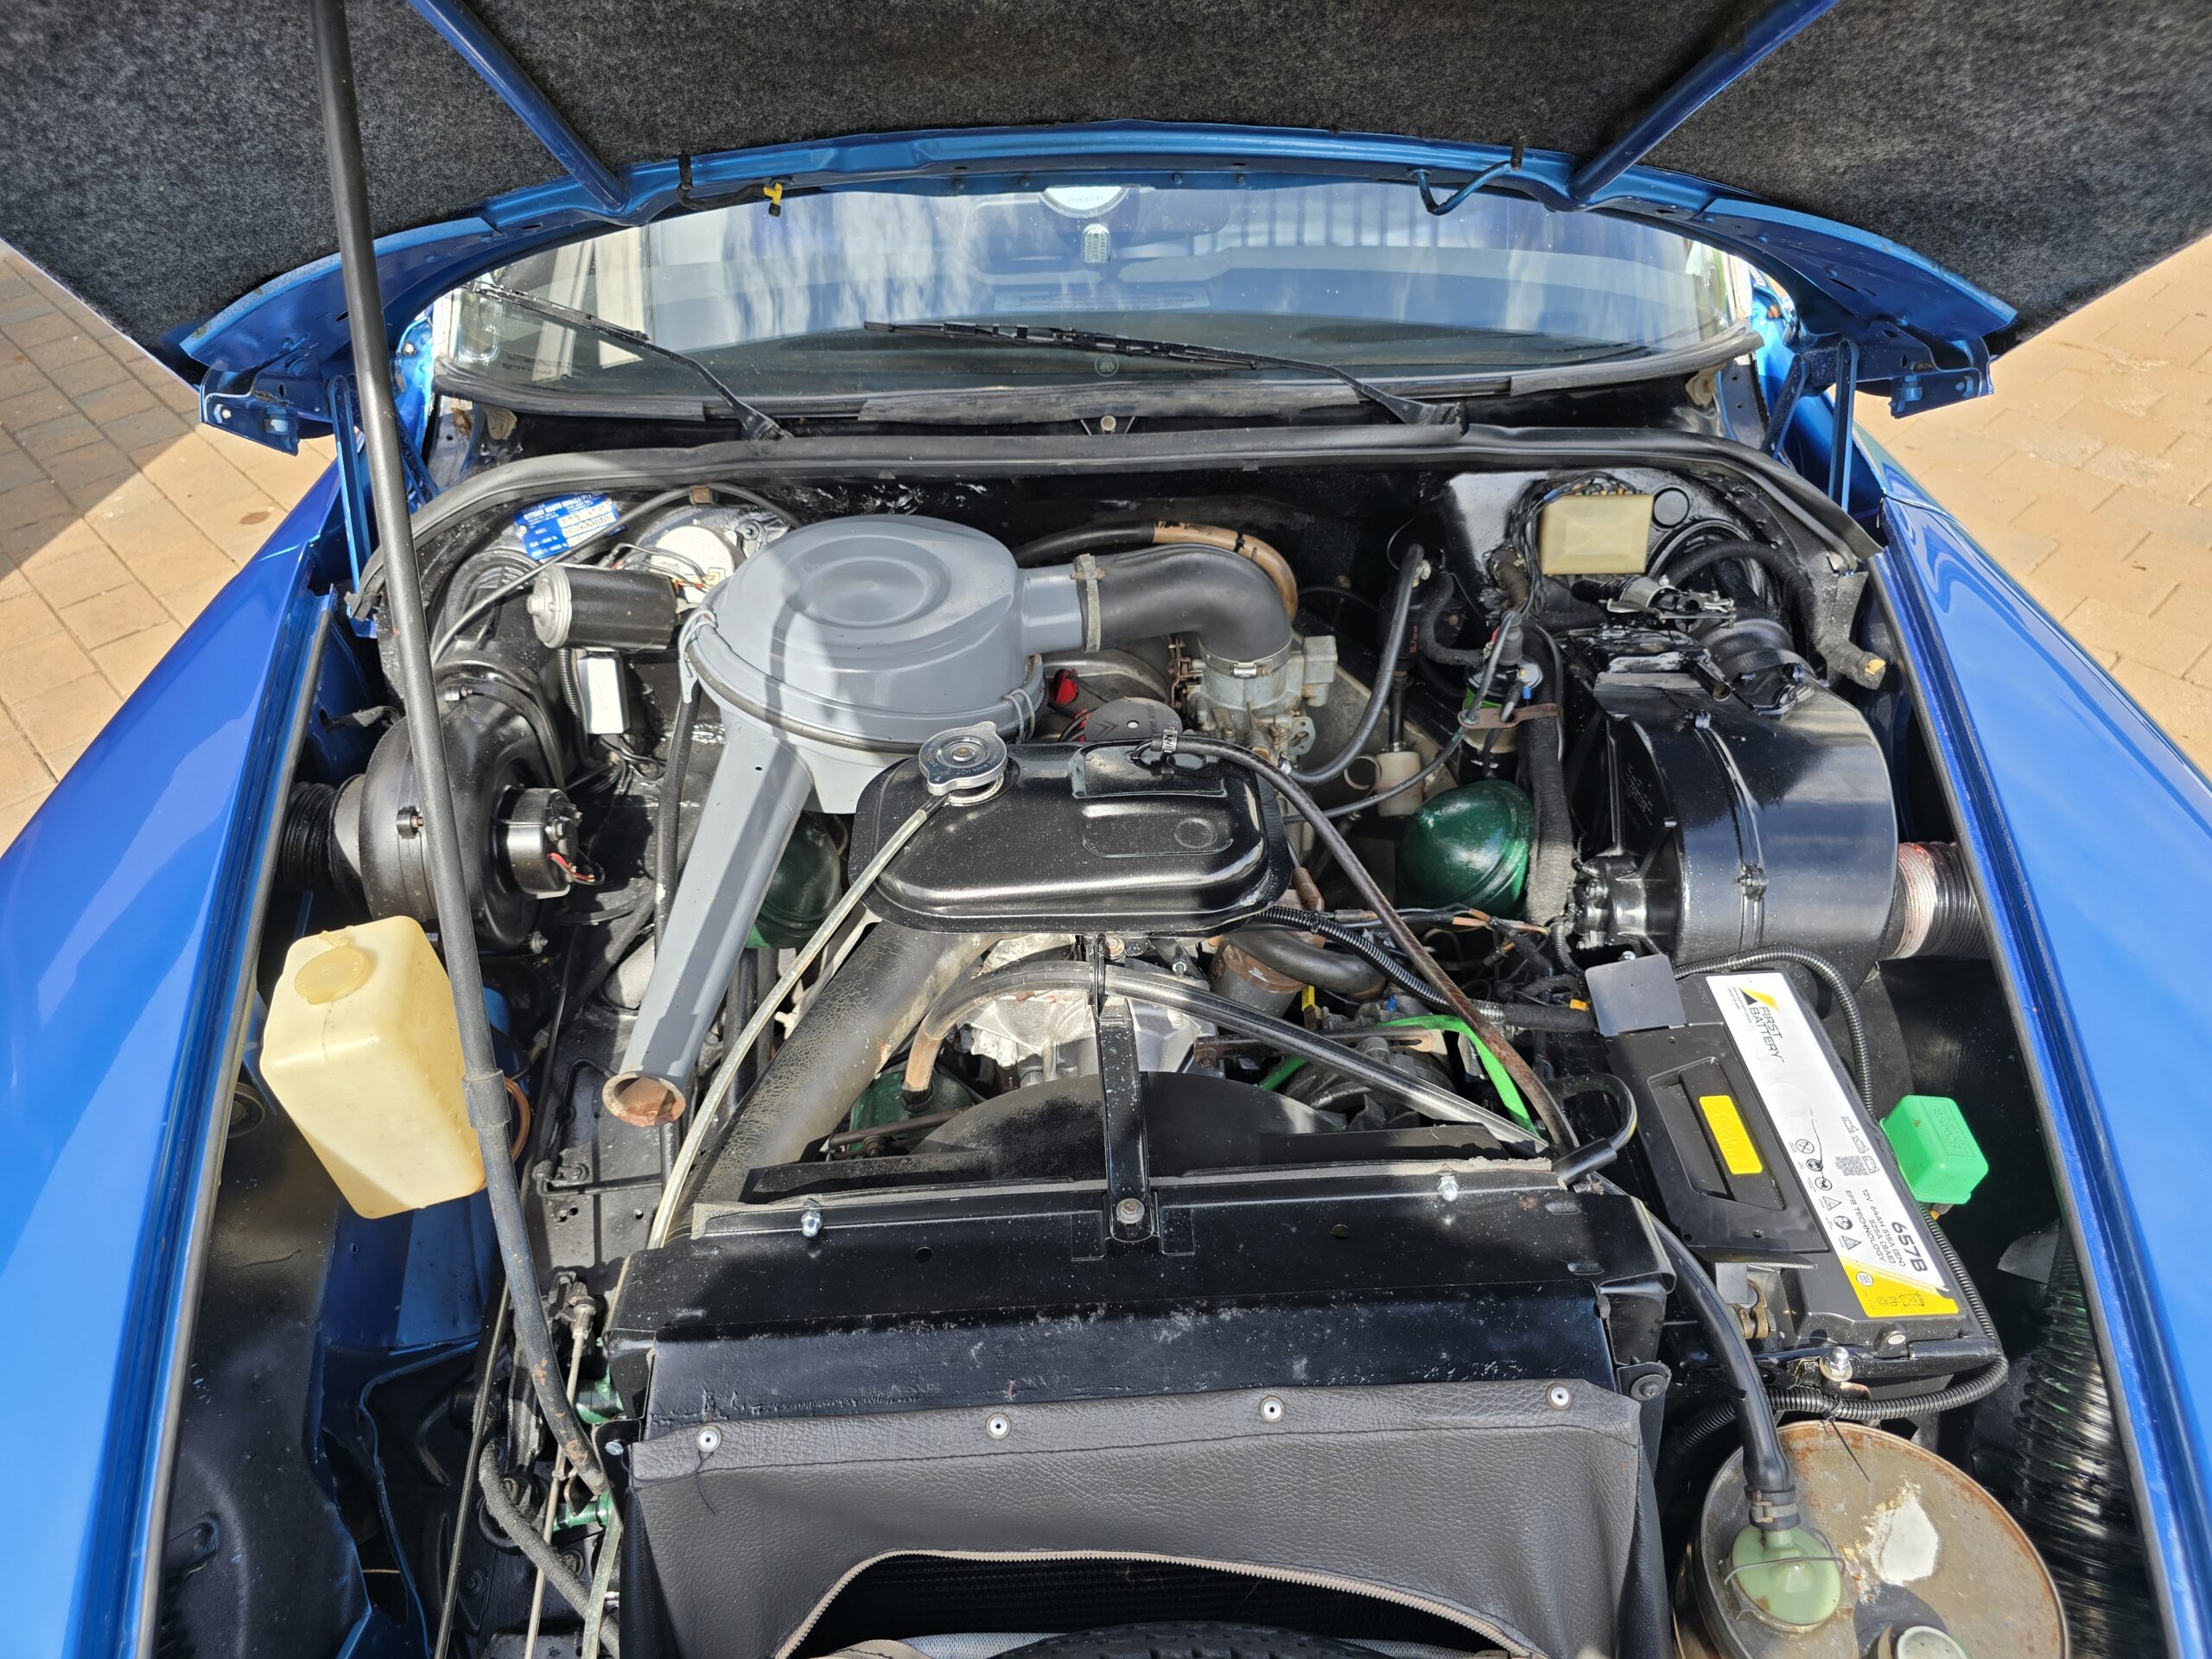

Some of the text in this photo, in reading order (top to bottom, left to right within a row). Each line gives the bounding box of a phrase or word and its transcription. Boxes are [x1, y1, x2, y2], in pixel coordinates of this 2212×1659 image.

[1749, 1007, 1783, 1058] BATTERY
[1758, 1007, 1783, 1039] FIRST
[1862, 1190, 1873, 1201] 12V
[1846, 1190, 1858, 1205] EFB
[1853, 1206, 1886, 1262] TECHNOLOGY
[1891, 1222, 1929, 1273] 657B
[1887, 1296, 1898, 1306] Pb
